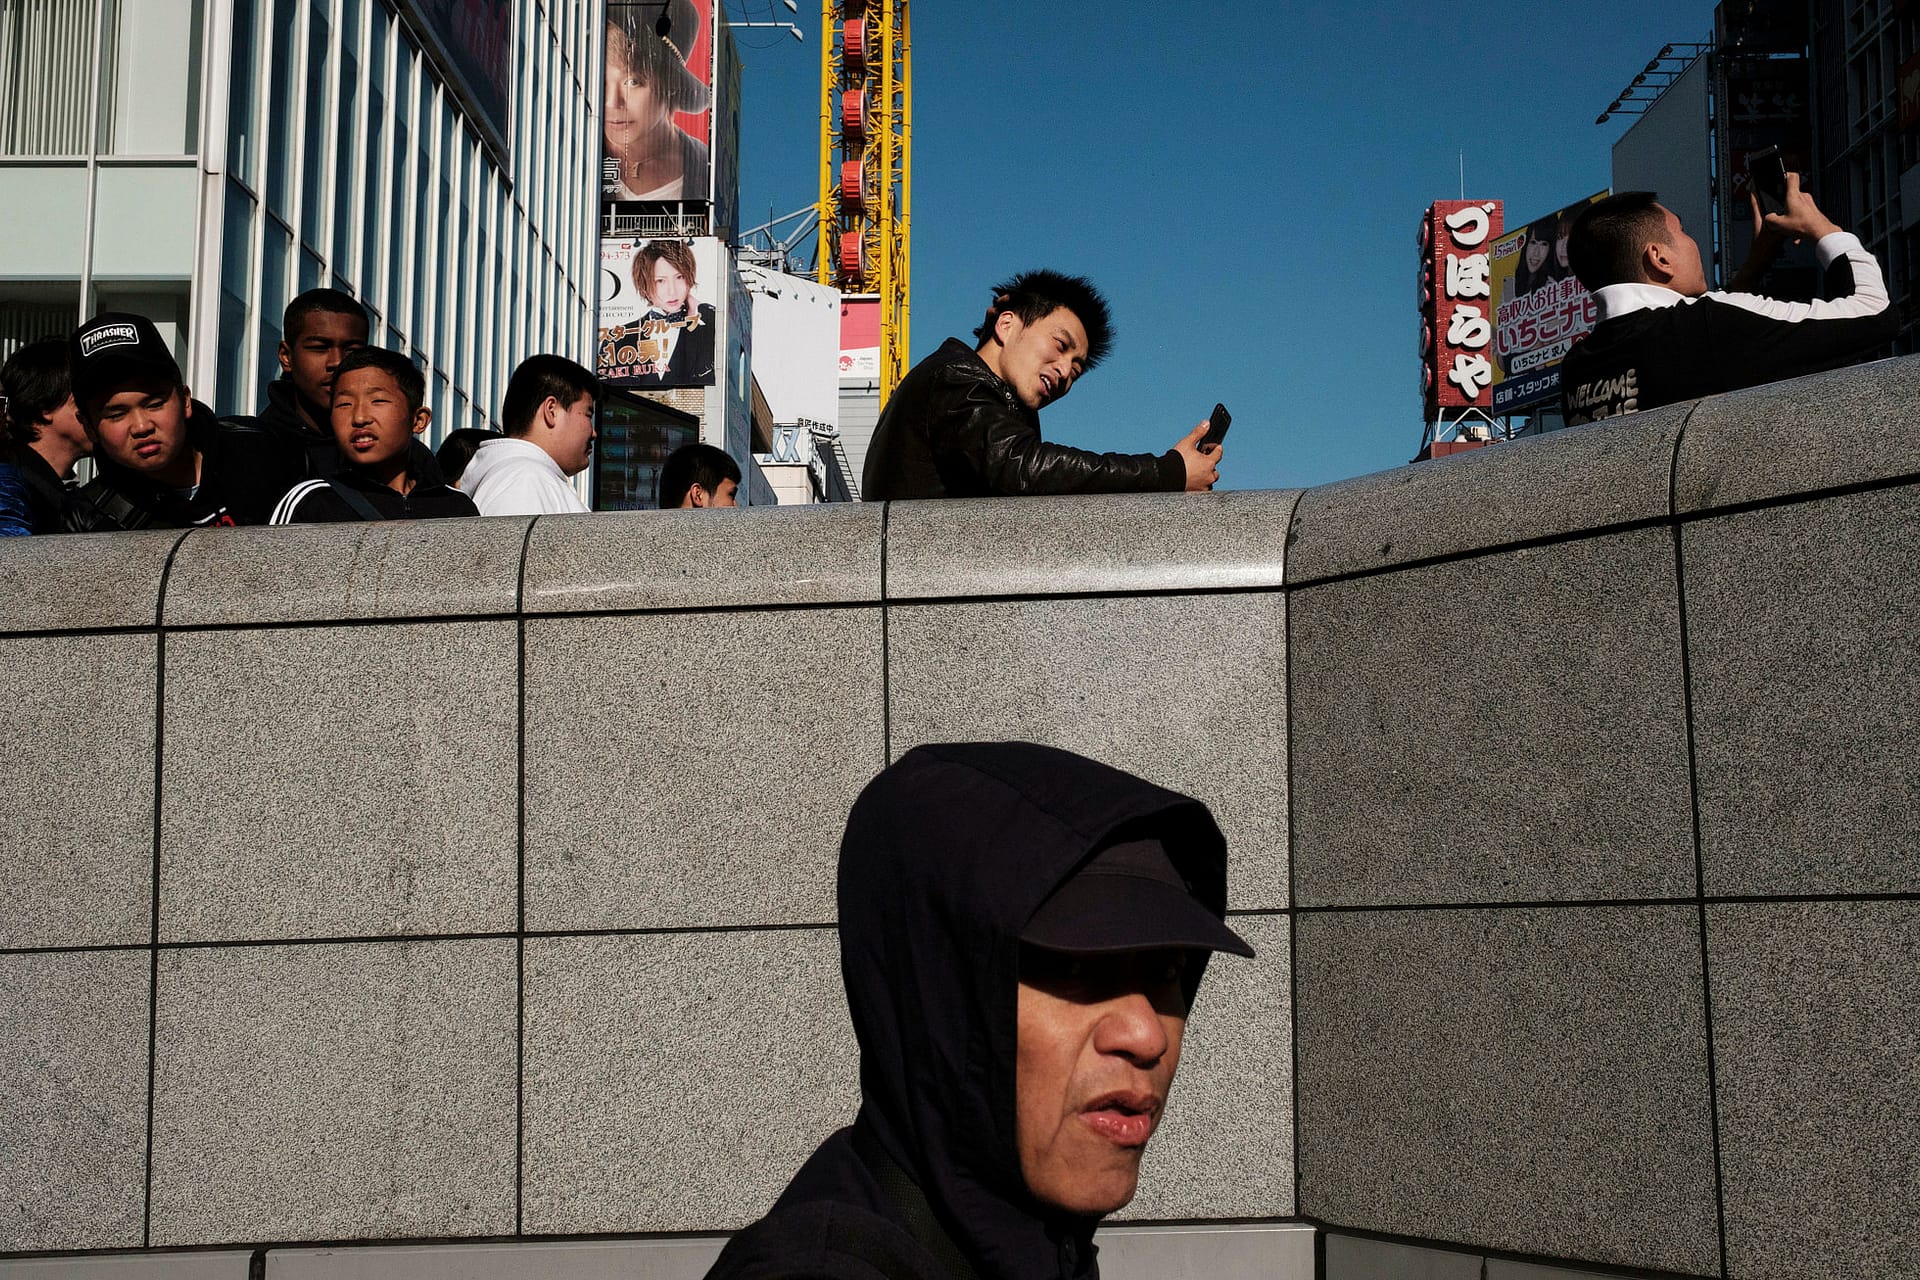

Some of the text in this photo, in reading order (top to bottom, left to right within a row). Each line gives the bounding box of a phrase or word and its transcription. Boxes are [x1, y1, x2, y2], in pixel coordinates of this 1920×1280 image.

[82, 327, 135, 352] THRASHER
[1445, 202, 1495, 399] づぼらや
